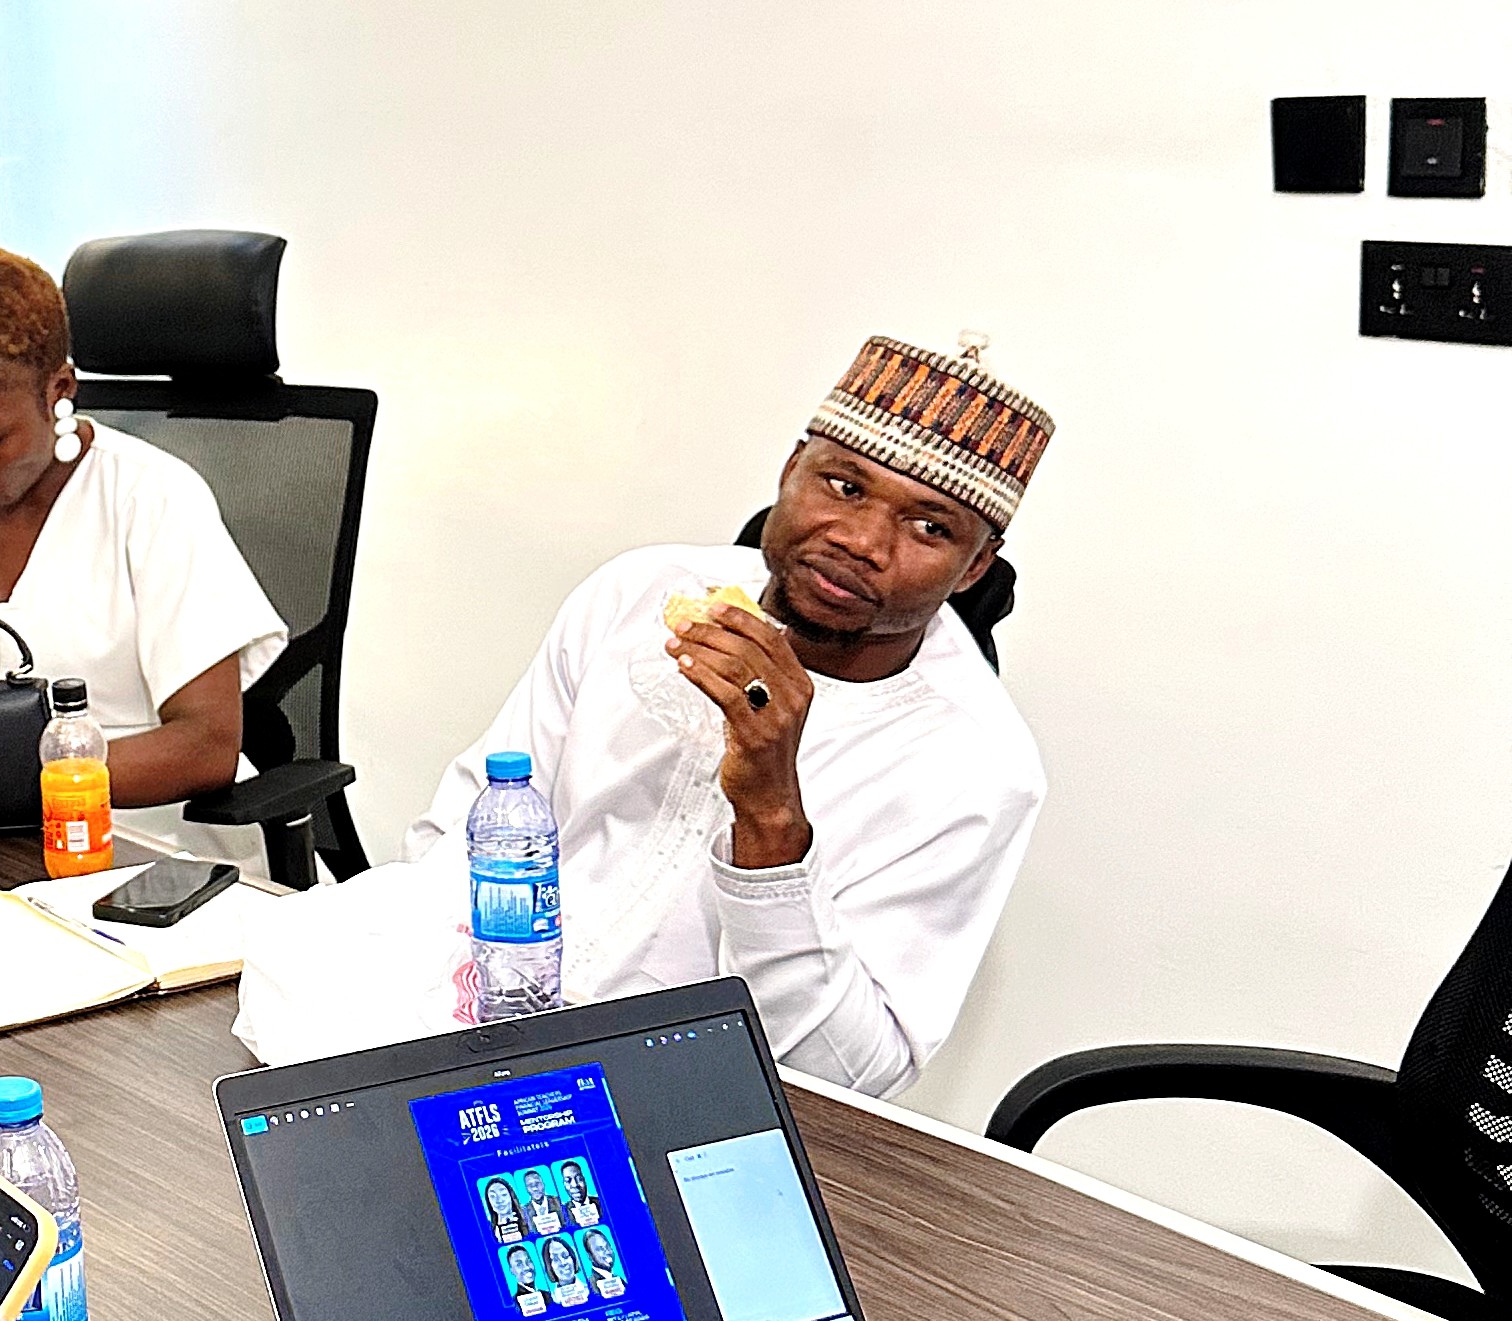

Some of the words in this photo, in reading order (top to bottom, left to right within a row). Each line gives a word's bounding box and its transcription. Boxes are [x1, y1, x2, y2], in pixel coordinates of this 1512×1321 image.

[458, 1103, 502, 1131] ATFLS
[522, 1115, 576, 1134] PROGRAM
[470, 1123, 501, 1142] 2026
